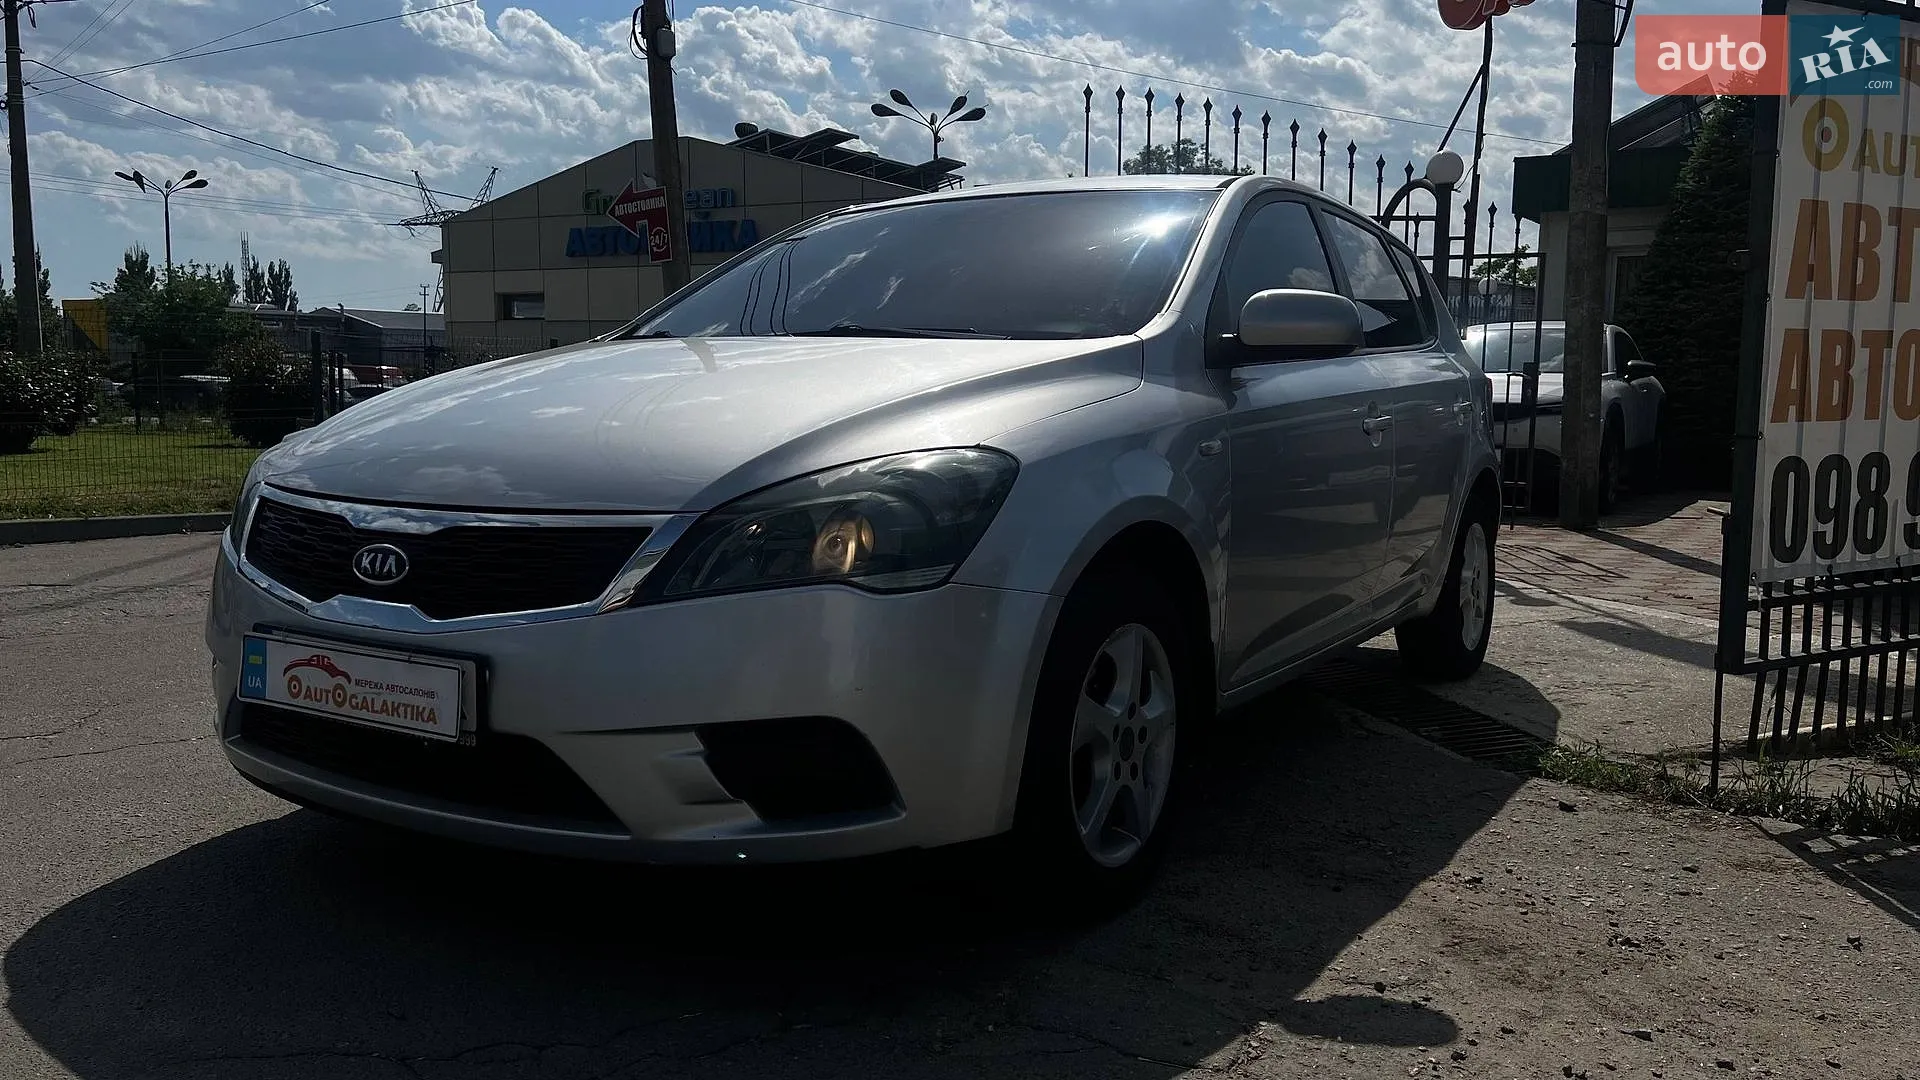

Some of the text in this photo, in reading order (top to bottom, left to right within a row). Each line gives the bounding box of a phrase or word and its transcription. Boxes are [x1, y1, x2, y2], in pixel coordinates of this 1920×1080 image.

[614, 195, 666, 218] АВТОСТОЯНКА
[650, 232, 669, 248] 24/7
[1768, 451, 1891, 565] 098
[360, 552, 397, 577] KIA
[248, 675, 263, 690] UA
[354, 678, 437, 700] МЕРЕЖА АВТОСАЛОНІВ
